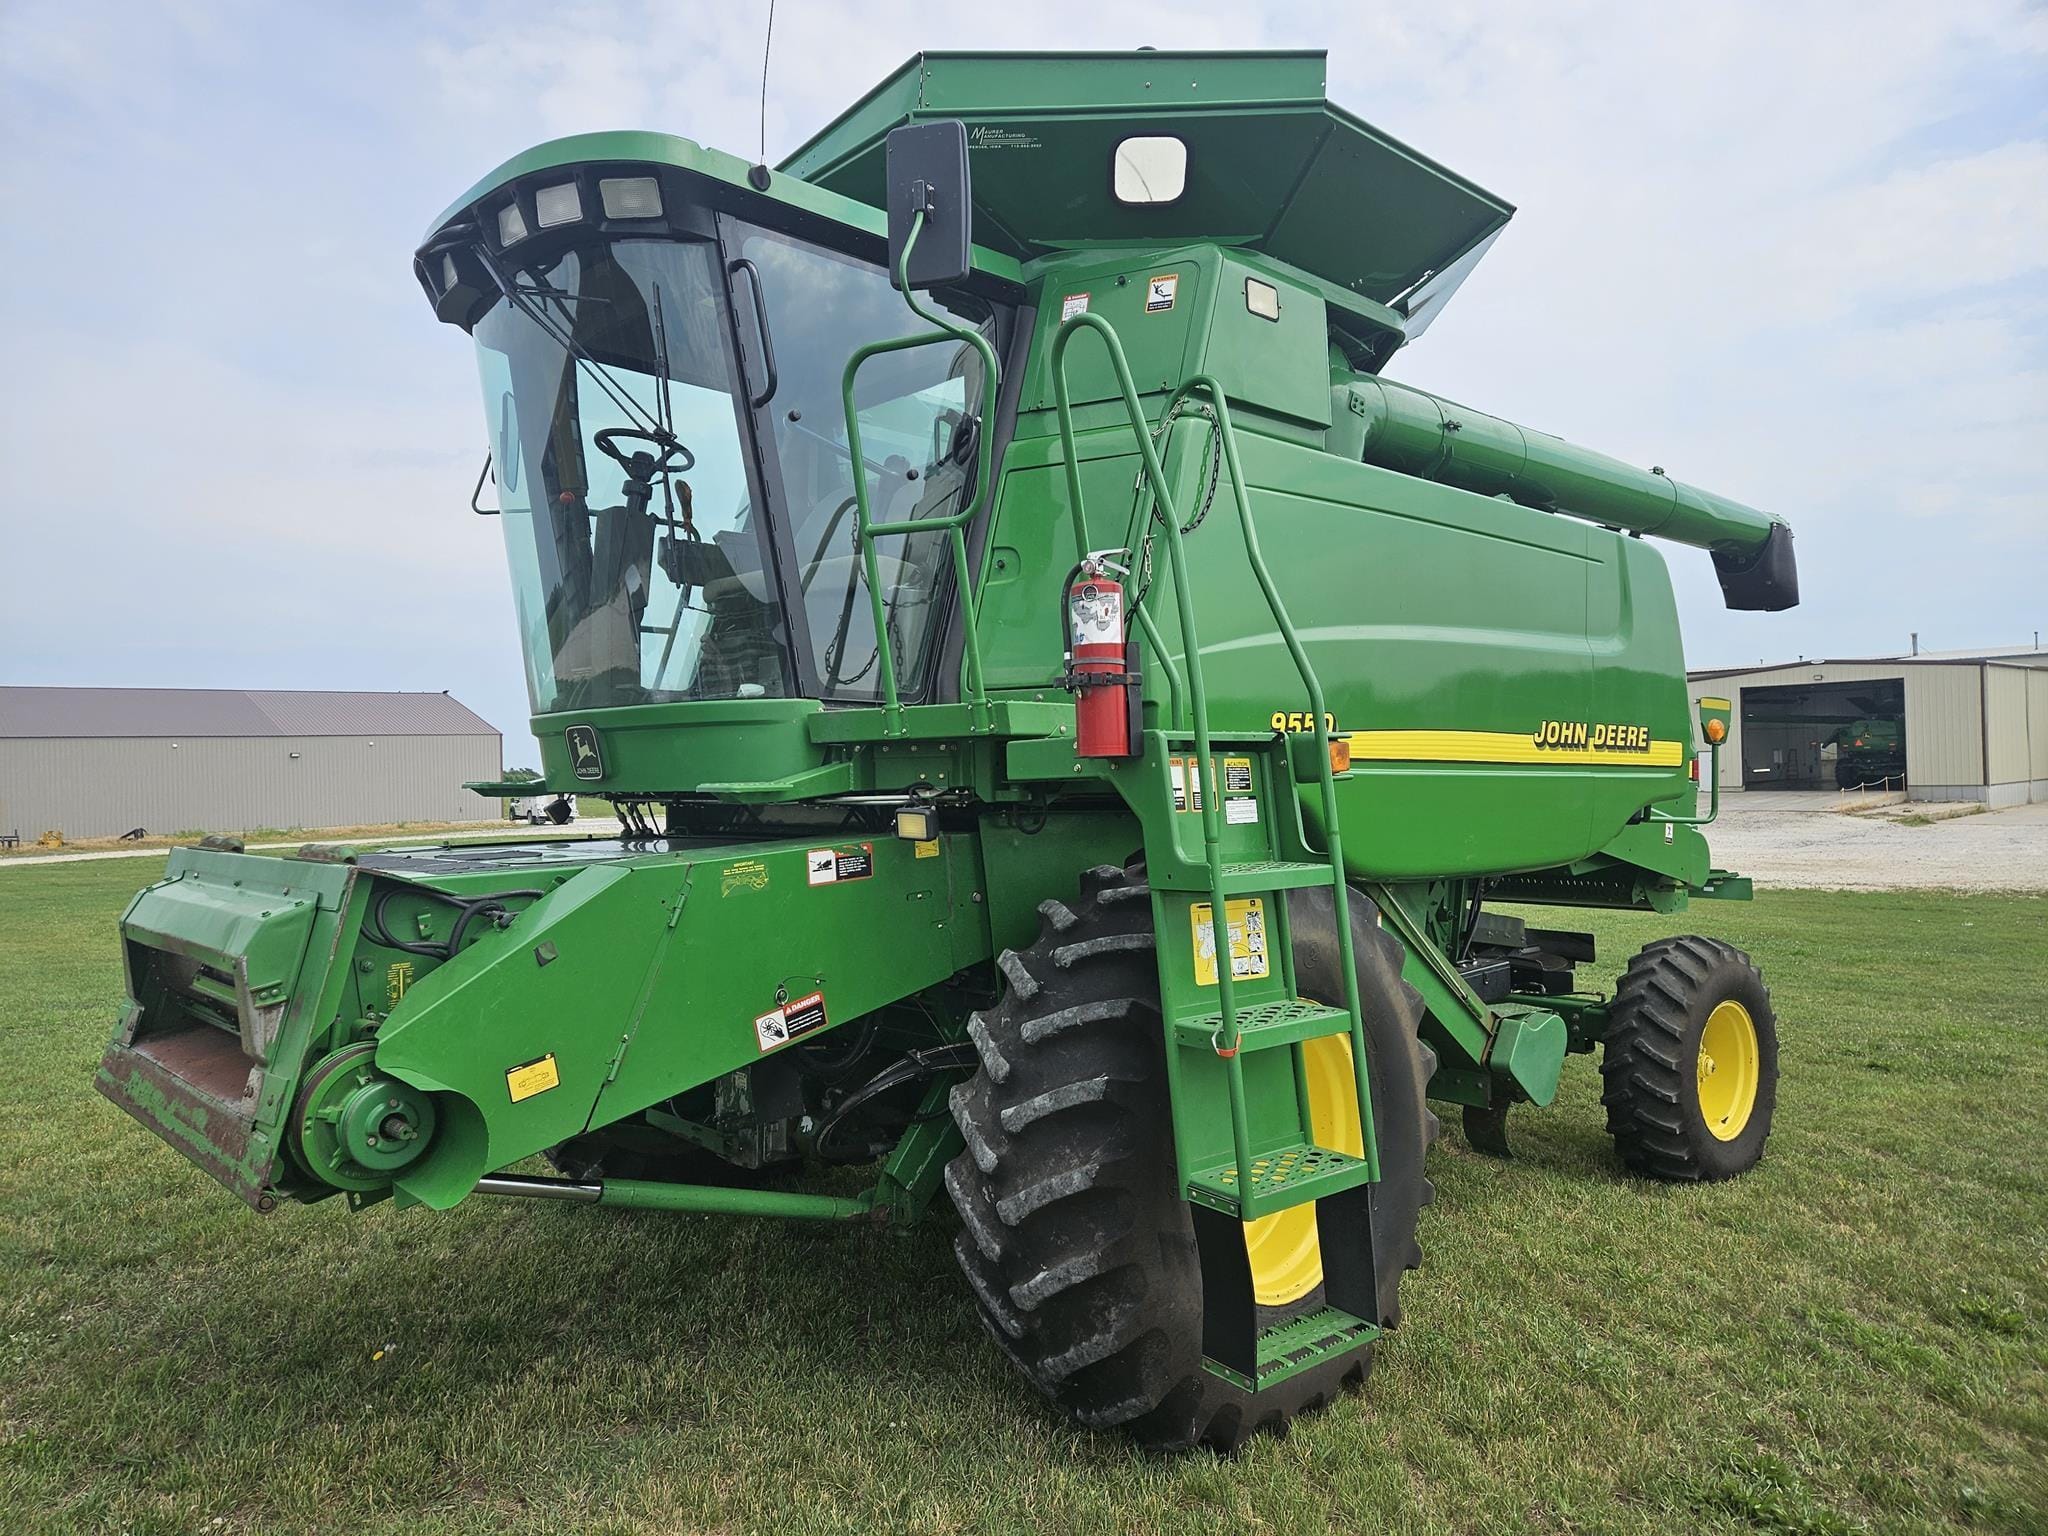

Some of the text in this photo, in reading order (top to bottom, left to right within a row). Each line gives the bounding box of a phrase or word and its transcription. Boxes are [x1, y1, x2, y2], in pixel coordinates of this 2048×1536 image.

[1534, 720, 1650, 751] JOHN DEERE
[792, 994, 821, 1011] DANGER
